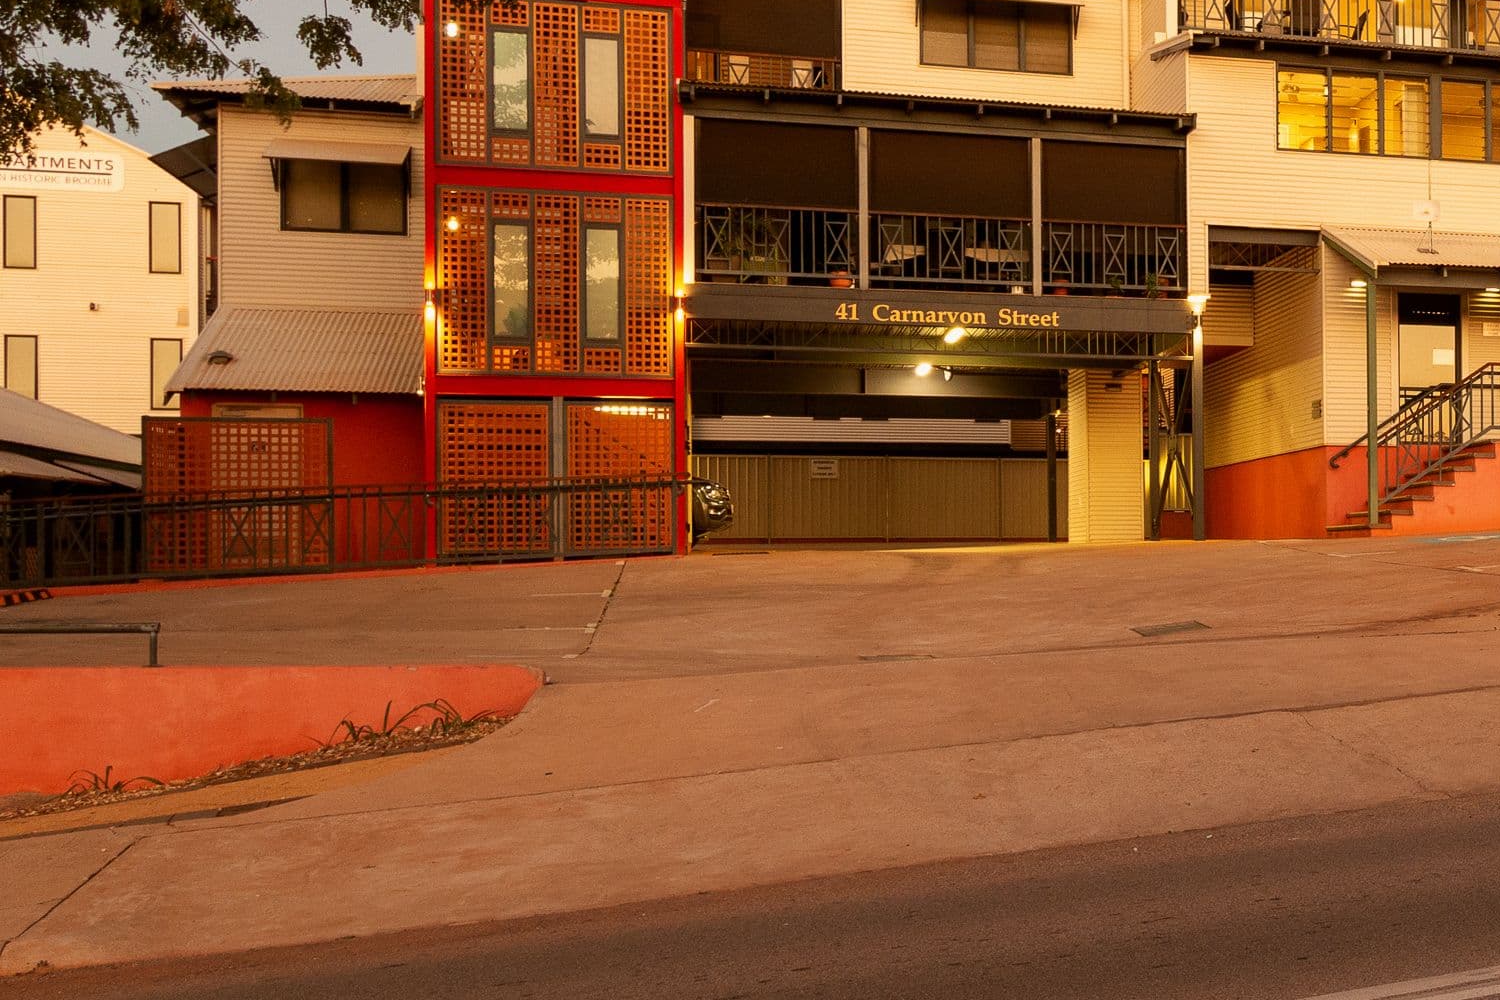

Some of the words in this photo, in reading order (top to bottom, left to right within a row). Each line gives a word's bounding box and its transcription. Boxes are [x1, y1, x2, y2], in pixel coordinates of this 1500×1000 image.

[3, 153, 114, 171] ARTMENTS
[835, 303, 859, 321] 41
[872, 304, 987, 325] Carnarvon
[998, 308, 1060, 327] Street
